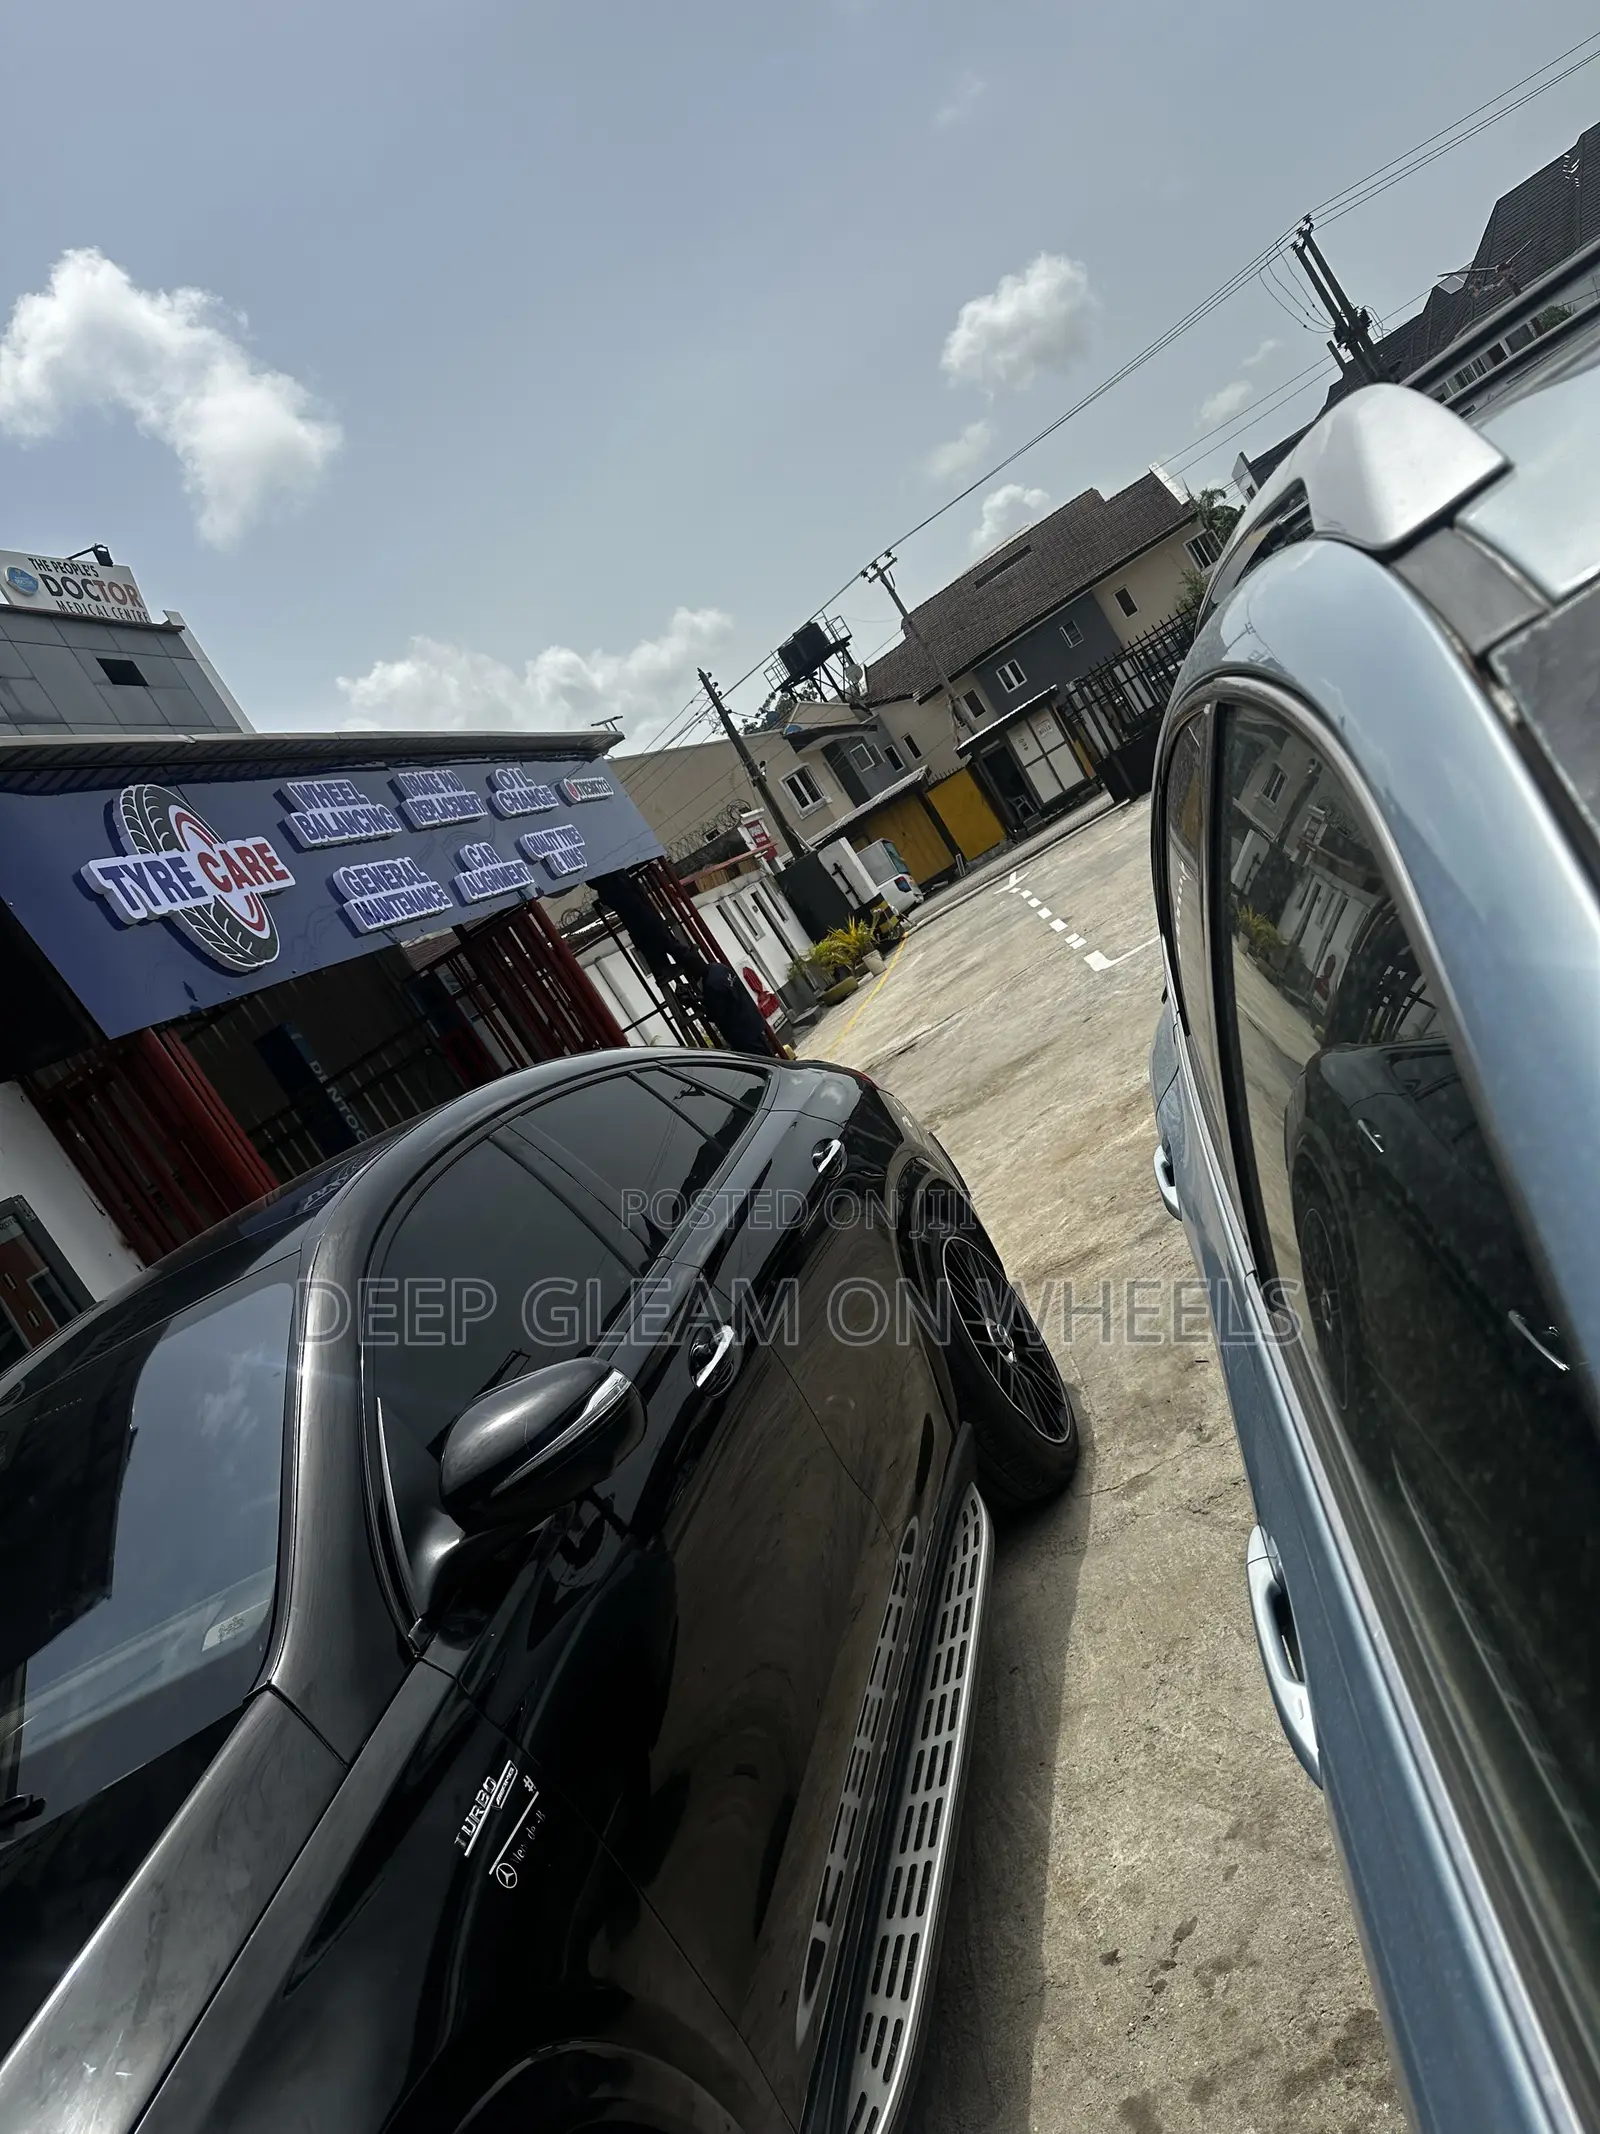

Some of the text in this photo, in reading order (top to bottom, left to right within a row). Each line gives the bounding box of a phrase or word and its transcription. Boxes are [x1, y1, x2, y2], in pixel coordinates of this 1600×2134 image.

[28, 558, 99, 578] THE PEOPLE'S
[38, 574, 143, 608] DOCTOR
[56, 600, 150, 624] MEDICAL CENTRE
[289, 779, 368, 810] WHEEL
[400, 771, 464, 798] BRAKE PAD
[501, 768, 534, 791] OIL
[409, 793, 487, 823] REPLACEMENT
[501, 786, 556, 813] CHANGE
[294, 806, 398, 842] BALANCING
[467, 843, 499, 869] CAR
[526, 826, 583, 856] QUALITY TYRES
[551, 846, 586, 872] & RIMS
[97, 842, 289, 911] TYRE CARE
[343, 858, 428, 897] GENERAL
[465, 862, 532, 899] ALIGNMENT
[353, 883, 450, 925] MAINTENANCE
[453, 1776, 498, 1850] TURBO
